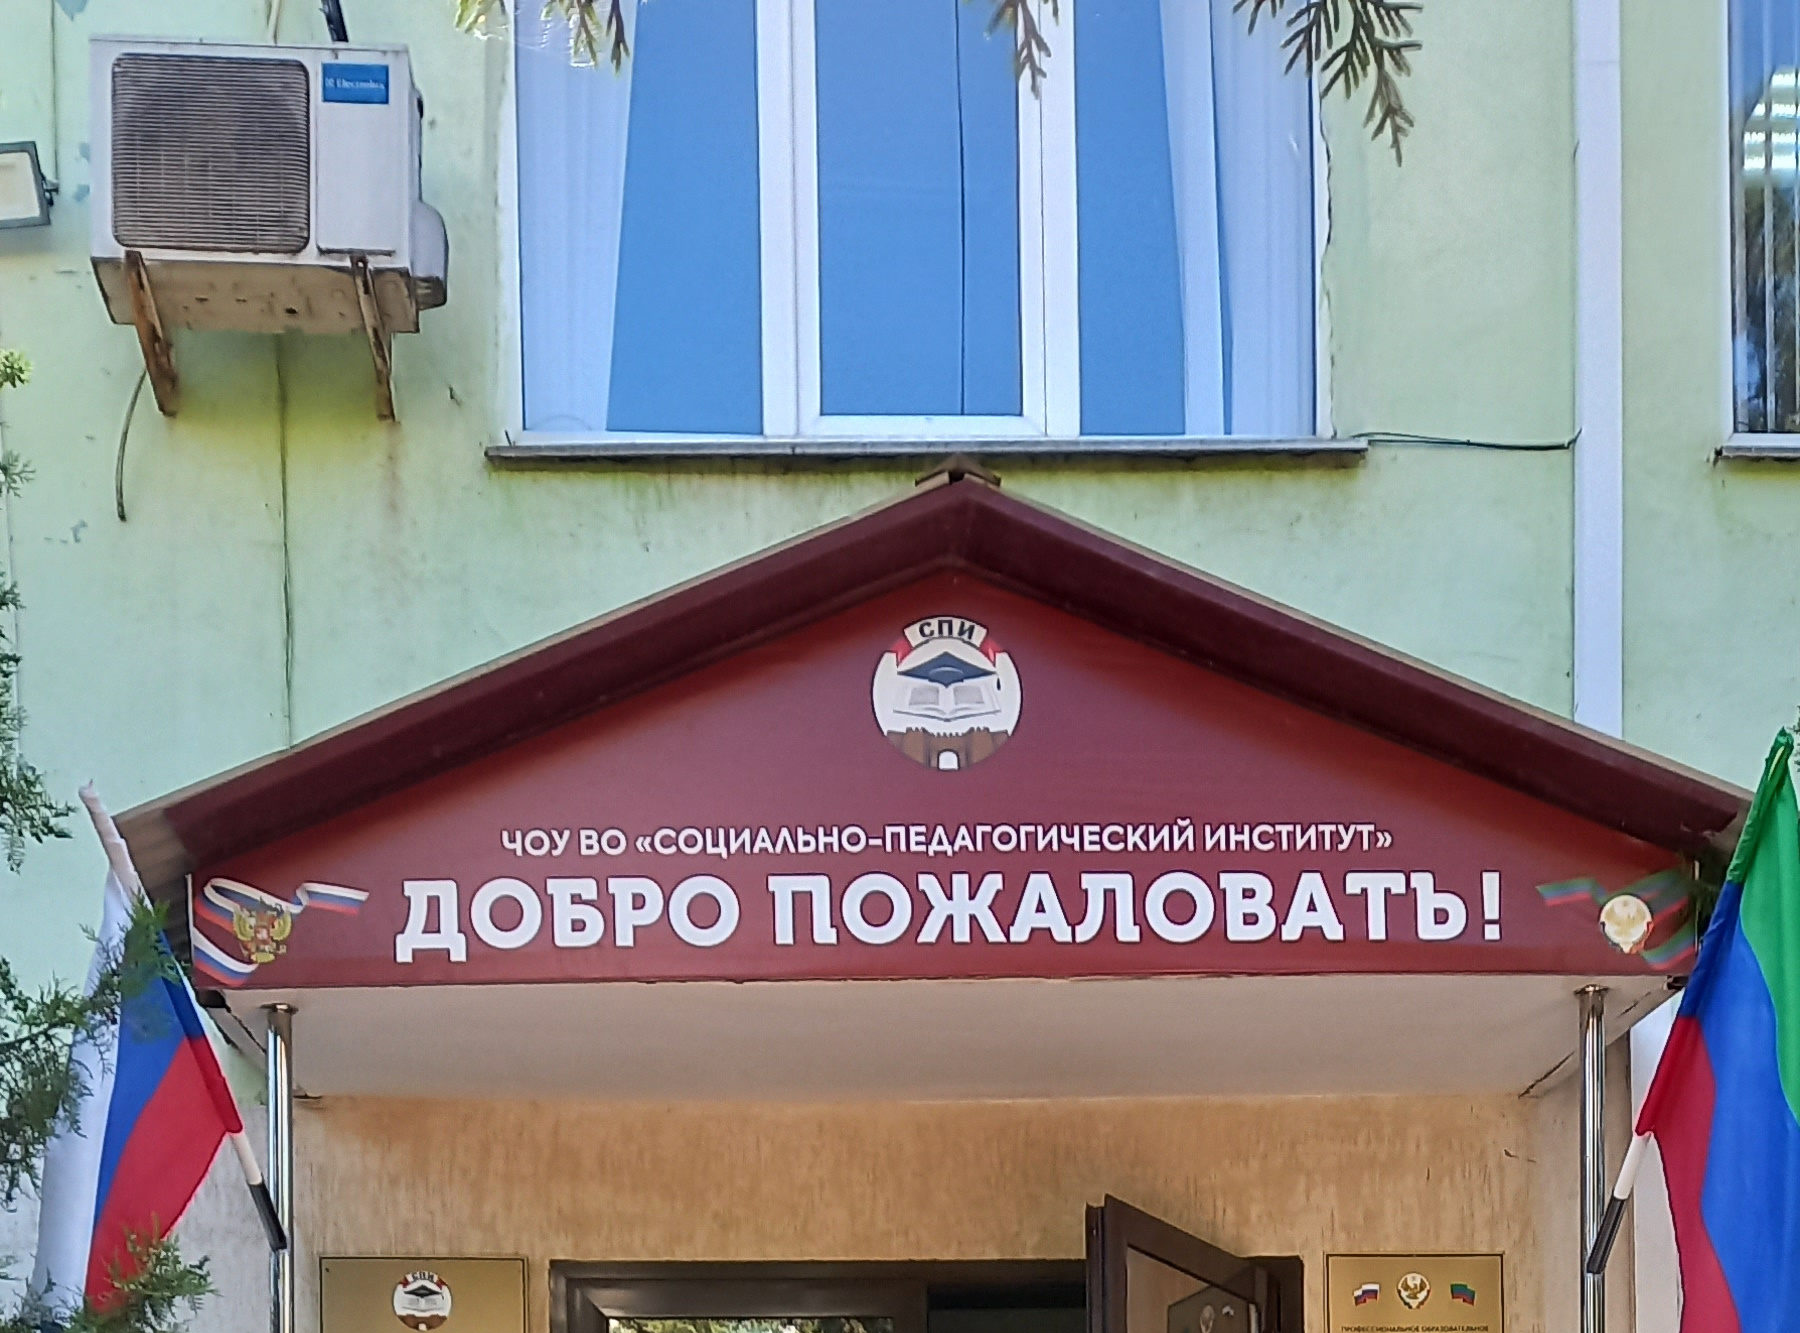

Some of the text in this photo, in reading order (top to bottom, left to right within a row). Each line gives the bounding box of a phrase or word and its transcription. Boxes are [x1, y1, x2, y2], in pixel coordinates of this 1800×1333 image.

[918, 619, 976, 640] СПИ
[501, 818, 1393, 859] ЧОУ ВО «СОЦИАЛЬНО-ПЕДАГОГИЧЕСКИЙ ИНСТИТУТ»
[395, 869, 1501, 963] ДОБРО ПОЖАЛОВАТЬ!
